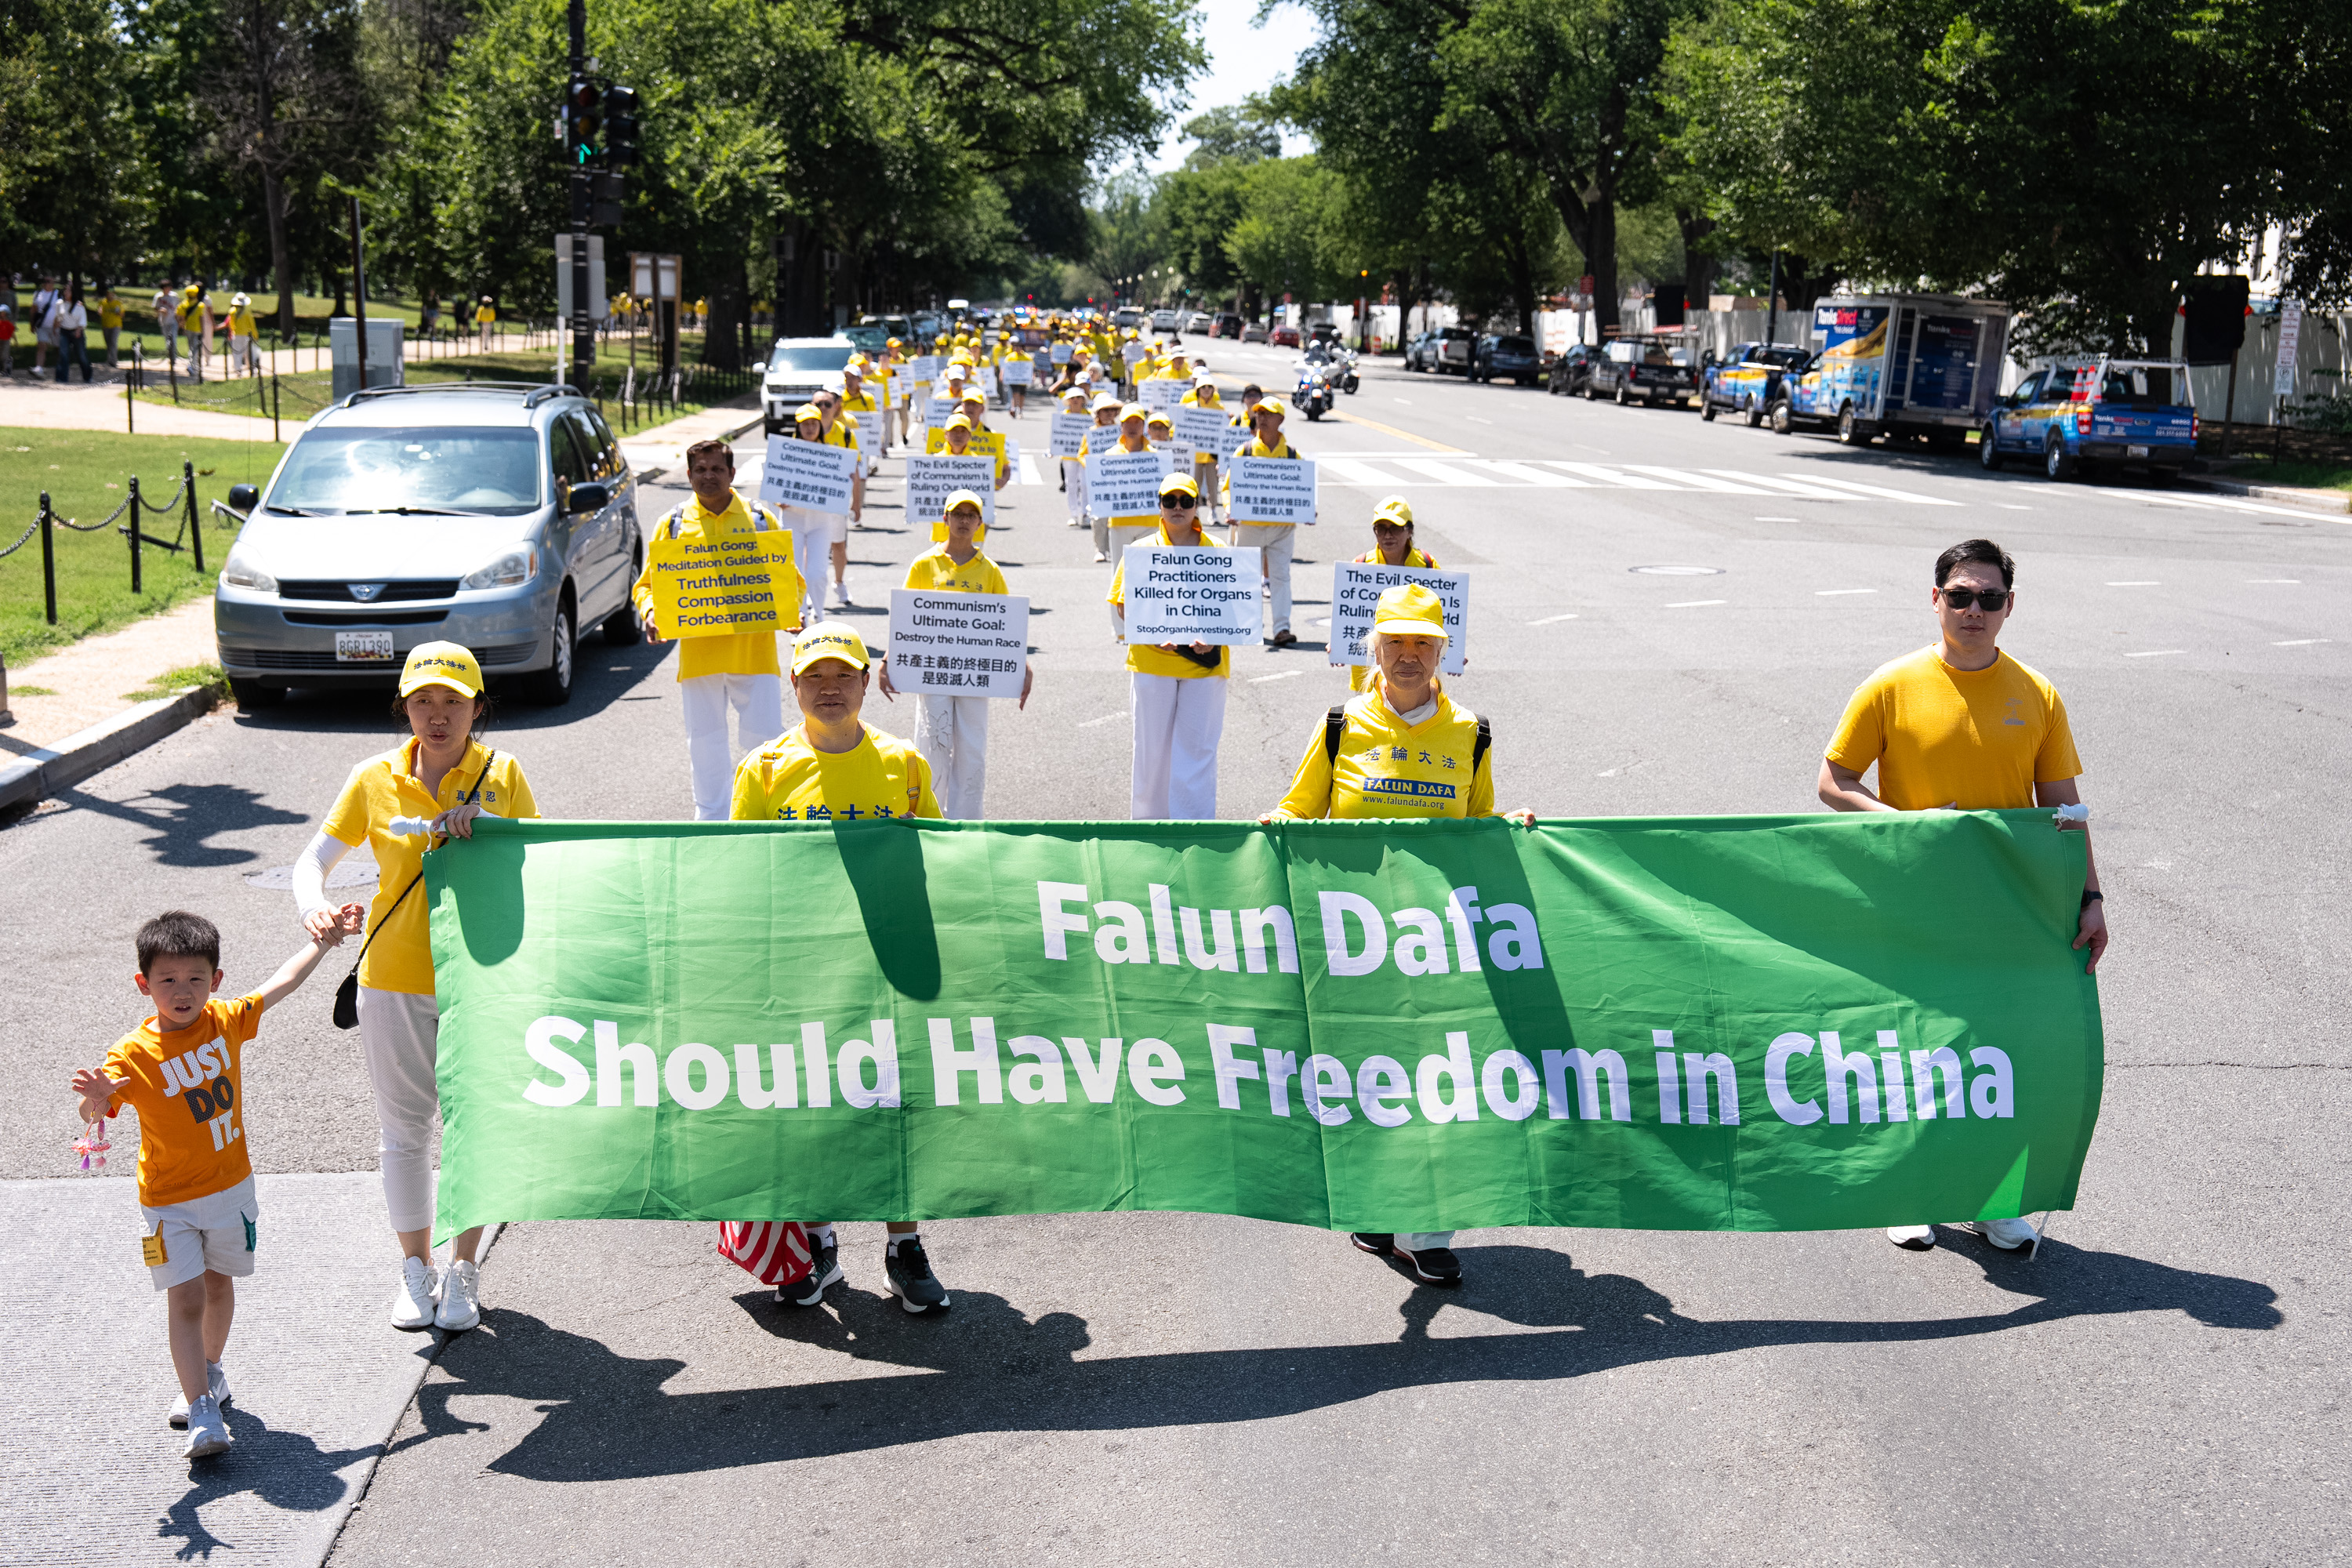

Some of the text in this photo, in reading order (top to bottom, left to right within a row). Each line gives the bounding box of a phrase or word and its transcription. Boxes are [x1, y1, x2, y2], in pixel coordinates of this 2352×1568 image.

[782, 442, 842, 460] Communism's
[780, 453, 817, 467] Ultimate
[952, 461, 986, 470] Specter
[1100, 456, 1159, 466] Communism's
[1243, 461, 1301, 470] Communism's
[768, 463, 794, 474] Destroy
[808, 470, 831, 481] Human
[922, 472, 981, 481] Communism
[1101, 468, 1135, 477] Ultimate
[1243, 472, 1278, 481] Ultimate
[911, 483, 989, 493] Ruling Our World
[684, 541, 757, 554] Falun Gong:
[657, 554, 787, 572] Meditation Guided by
[1152, 554, 1232, 568] Falun Gong
[676, 574, 771, 590] Truthfulness
[1149, 571, 1236, 583] Practitioners
[1346, 570, 1372, 583] The
[1376, 572, 1400, 585] Evil
[677, 590, 774, 608] Compassion
[1134, 587, 1251, 602] Killed for Organs
[1341, 587, 1356, 599] of
[1450, 596, 1460, 608] Is
[913, 597, 1007, 614] Communism's
[1166, 605, 1221, 616] in China
[1339, 604, 1375, 619] Rulin
[677, 610, 776, 627] Forbearance
[913, 615, 1005, 631] Ultimate Goal:
[1137, 625, 1251, 635] StopOrganHarvesting.org
[339, 640, 390, 654] 8GR1390
[895, 632, 1021, 648] Destroy the Human Race
[897, 652, 1018, 673] 共產主義的終極目的
[922, 671, 989, 688] 是毀滅人類
[1365, 746, 1457, 769] 法輪大法
[1367, 779, 1453, 797] FALUN DAFA
[1363, 796, 1445, 810] www.falundafa.org
[1036, 879, 1544, 977] Falun Dafa
[158, 1034, 232, 1098] JUST
[522, 1015, 2015, 1127] Should Have Freedom in China
[183, 1075, 234, 1124] DO
[208, 1108, 240, 1152] IT.
